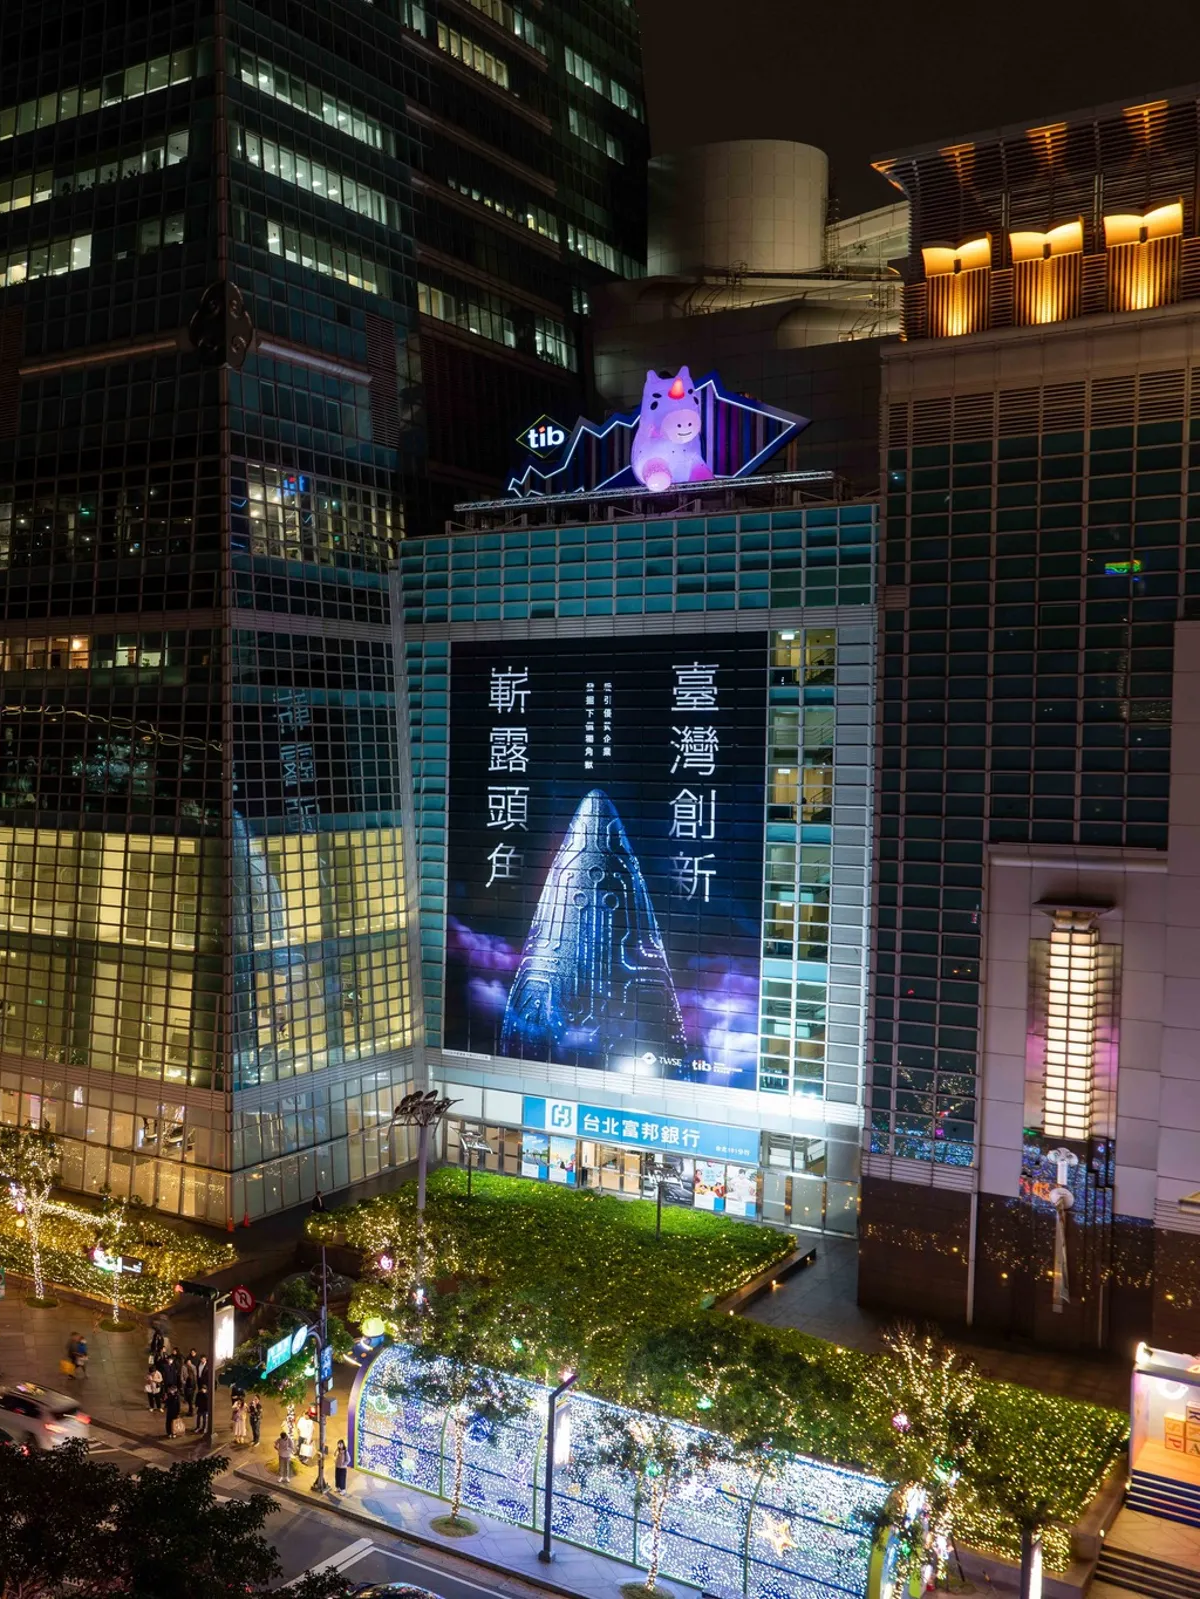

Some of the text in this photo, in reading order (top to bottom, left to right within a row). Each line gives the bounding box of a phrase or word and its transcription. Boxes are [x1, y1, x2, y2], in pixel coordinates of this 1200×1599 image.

[527, 425, 565, 449] tib
[485, 665, 532, 888] 嶄露頭角
[668, 661, 720, 903] 臺灣創新
[692, 1059, 712, 1072] tib
[583, 1112, 701, 1149] 台北富邦銀行
